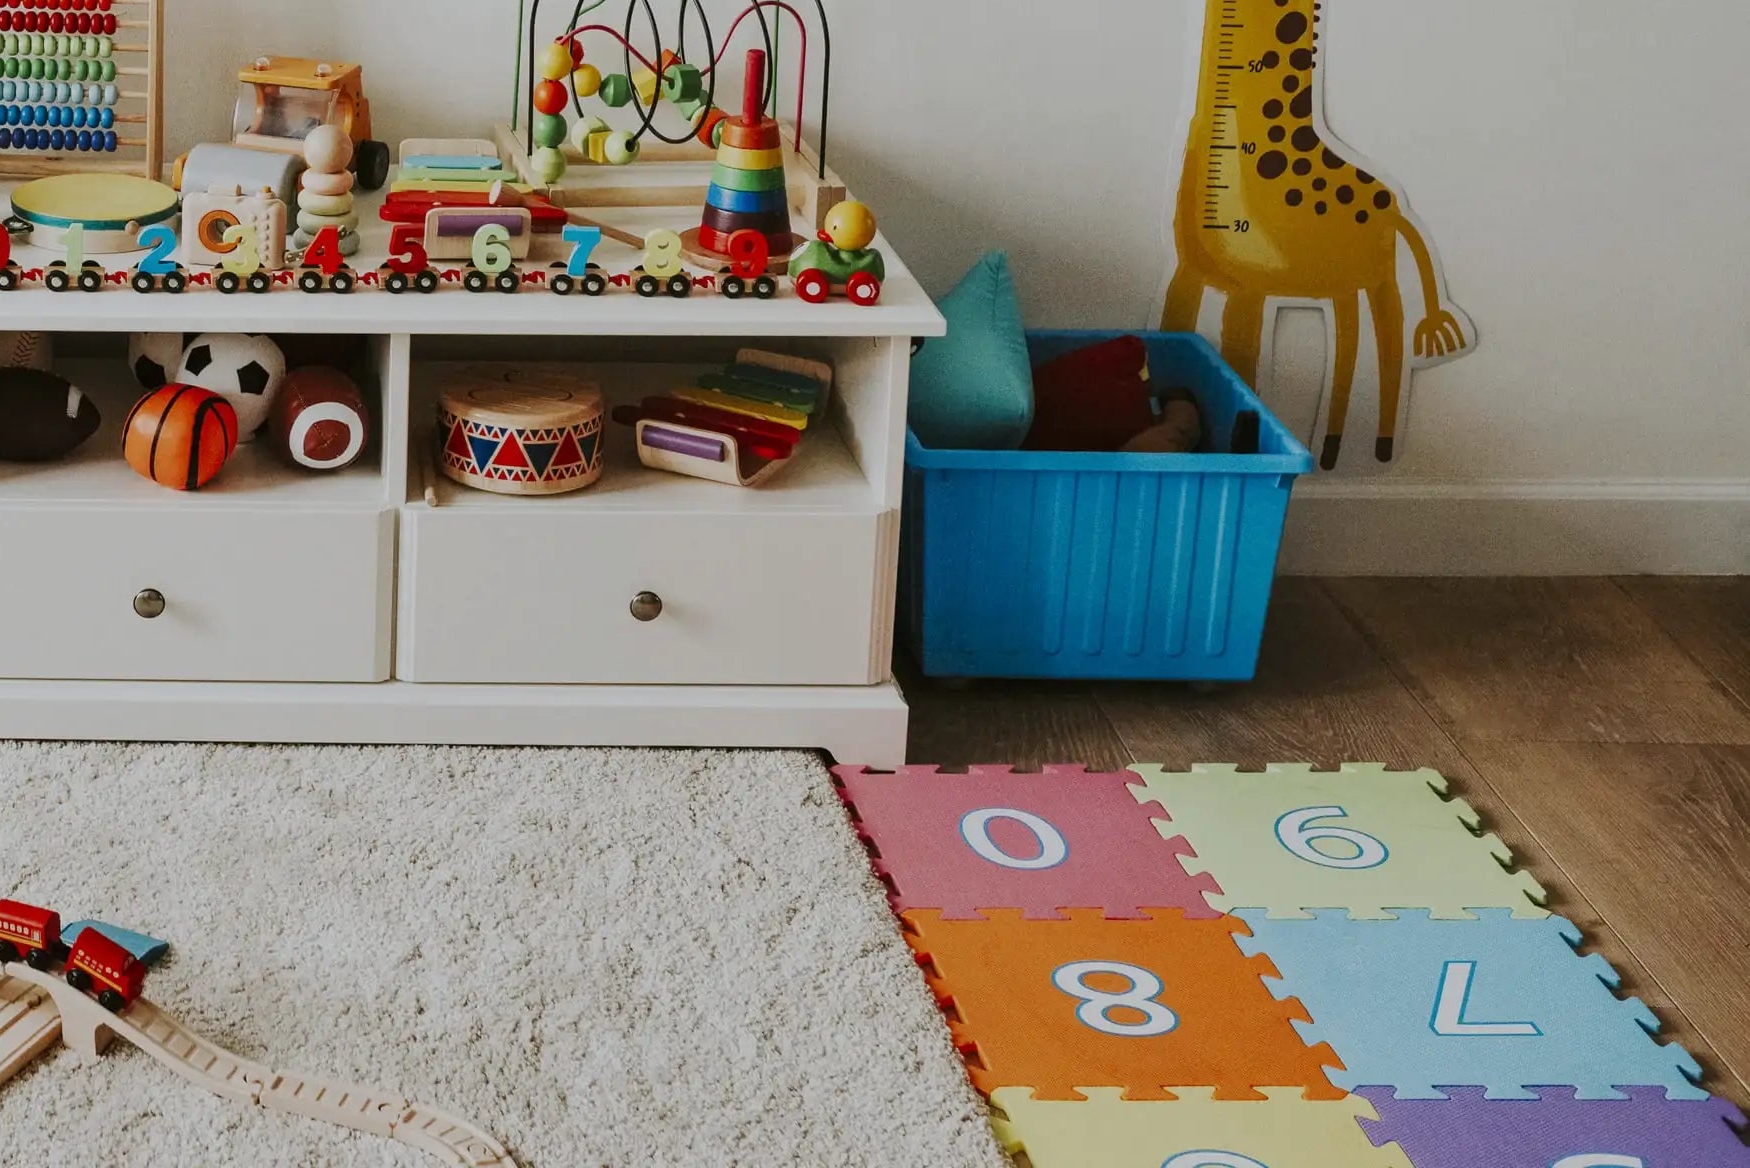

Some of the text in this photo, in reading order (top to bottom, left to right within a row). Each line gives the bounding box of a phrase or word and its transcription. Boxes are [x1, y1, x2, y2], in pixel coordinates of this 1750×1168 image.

[1248, 60, 1264, 73] 50
[1241, 142, 1256, 155] 40
[1233, 220, 1249, 233] 30
[63, 222, 85, 273] 1
[137, 223, 177, 275] 2
[221, 224, 260, 274] 3
[303, 224, 344, 275] 4
[388, 224, 428, 273] 5
[471, 223, 511, 273] 6
[561, 225, 602, 277] 7
[642, 228, 683, 277] 8
[727, 229, 769, 279] 9
[1050, 959, 1181, 1037] 8
